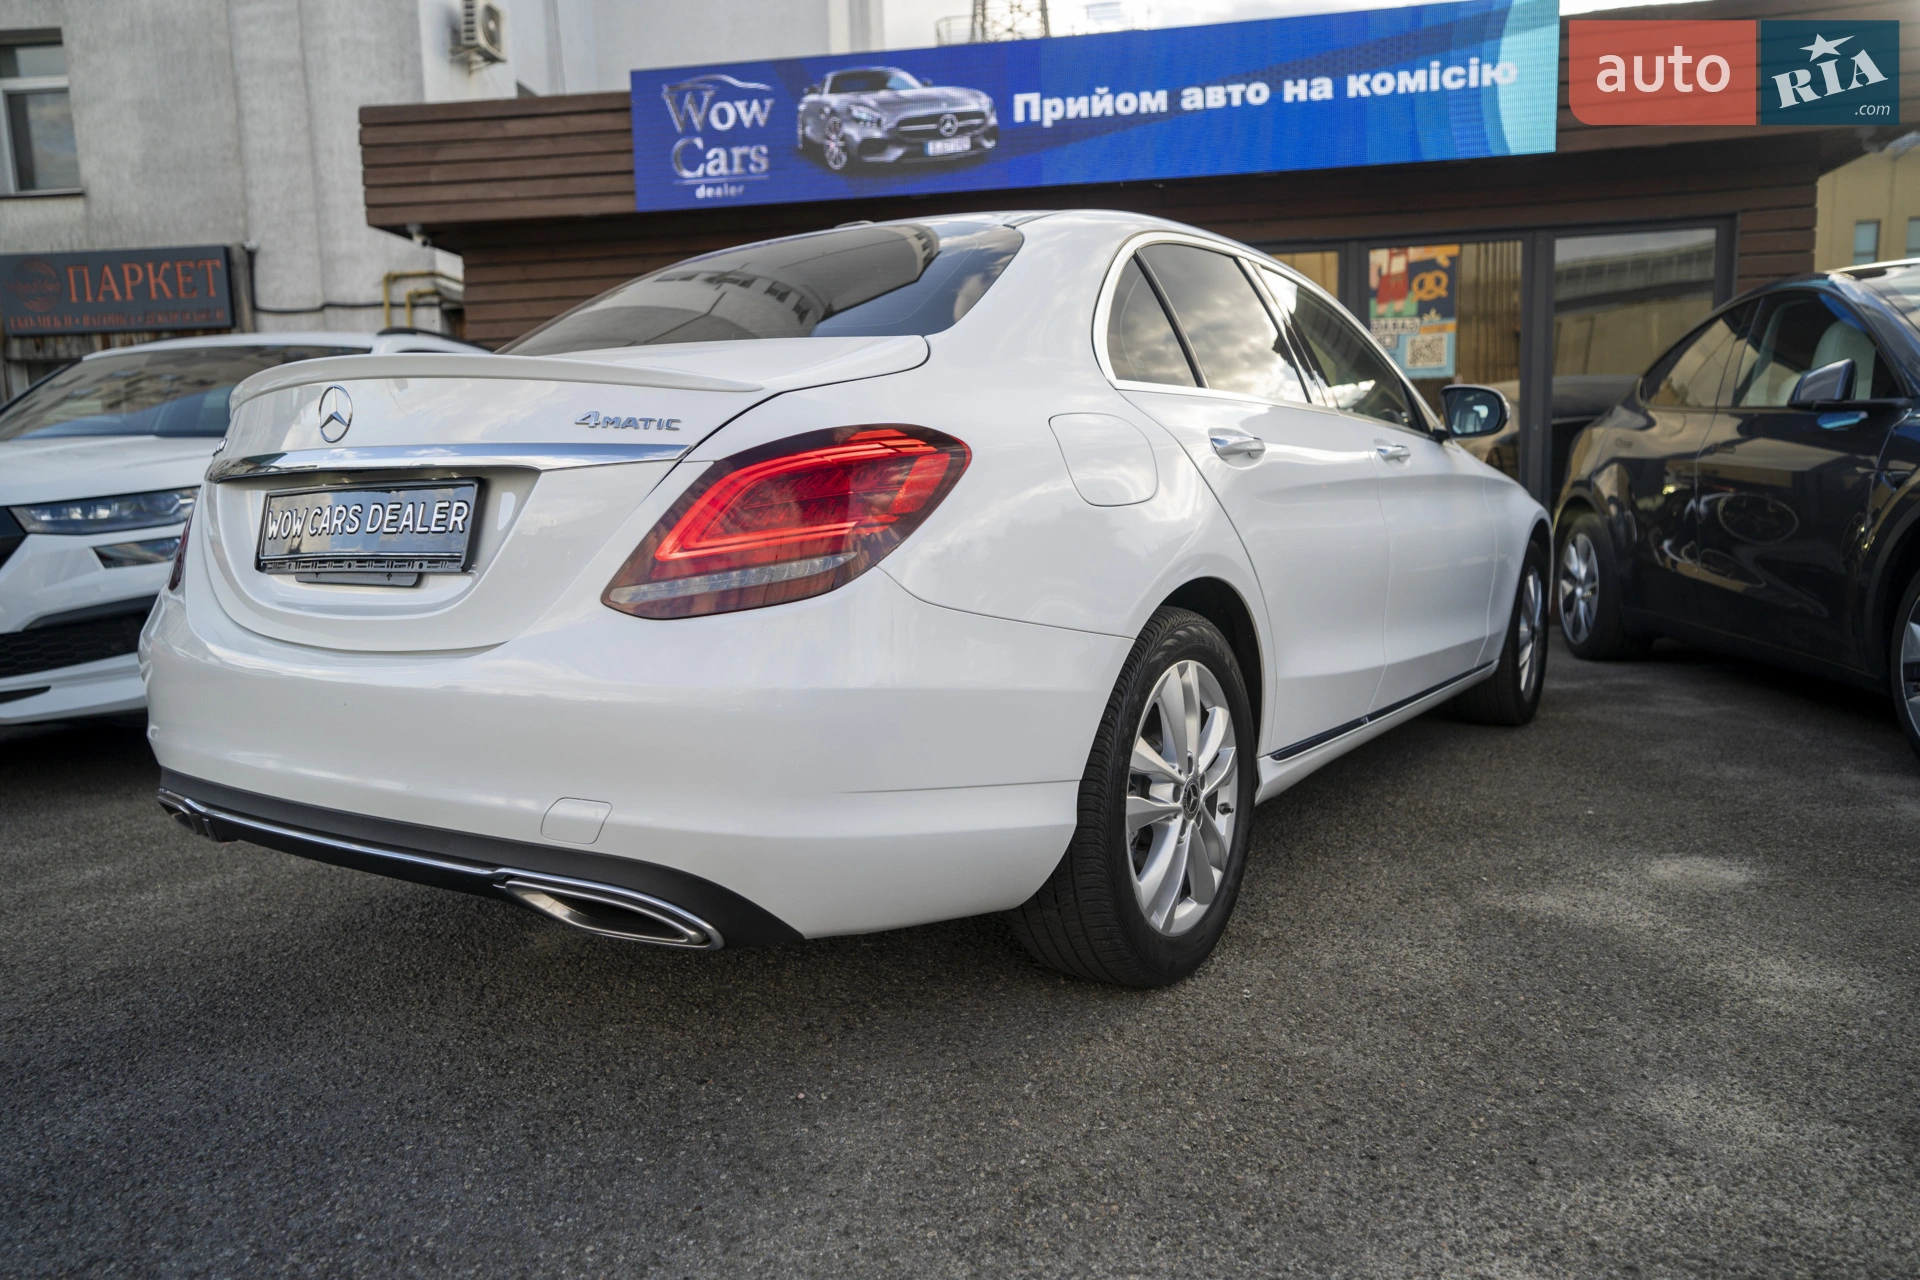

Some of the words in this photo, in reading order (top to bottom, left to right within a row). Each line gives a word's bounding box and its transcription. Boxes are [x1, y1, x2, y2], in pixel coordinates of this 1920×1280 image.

[1013, 88, 1168, 127] Прийом
[1181, 78, 1270, 112] авто
[1283, 75, 1333, 103] на
[1347, 57, 1518, 100] комісію
[671, 137, 771, 179] Cars
[695, 183, 745, 200] dealer
[66, 259, 222, 304] ПАРКЕТ
[575, 411, 682, 431] 4MATIC
[267, 507, 308, 540] WOW
[308, 503, 363, 536] CARS
[365, 500, 469, 535] DEALER
